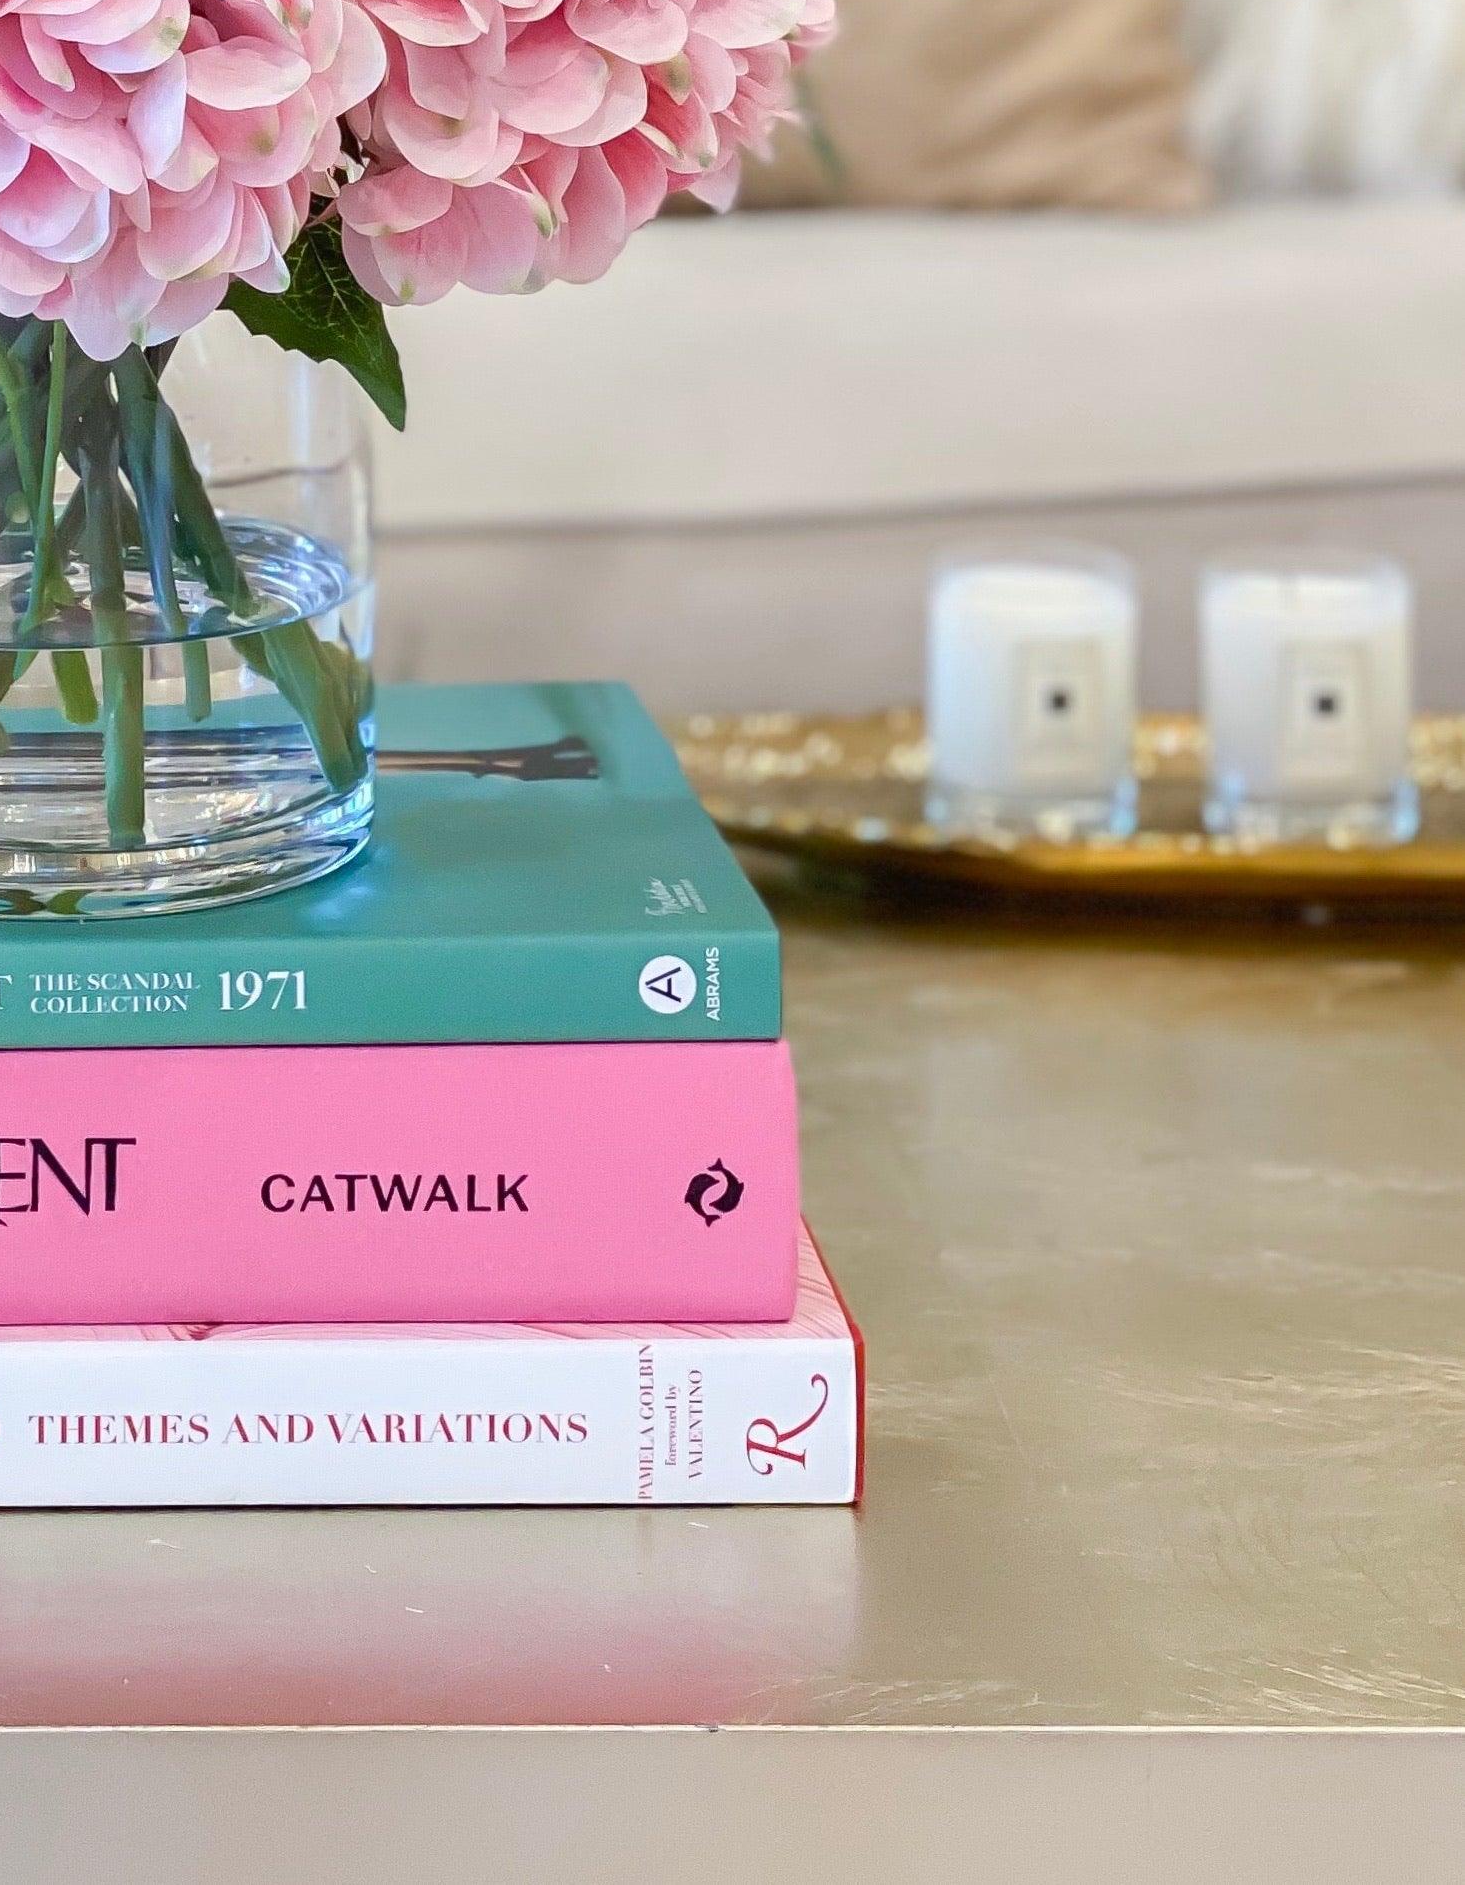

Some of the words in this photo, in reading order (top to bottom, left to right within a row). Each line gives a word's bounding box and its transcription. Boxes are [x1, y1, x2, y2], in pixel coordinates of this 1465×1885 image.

[29, 973, 82, 991] THE
[87, 971, 201, 991] SCANDAL
[218, 969, 307, 1011] 1971
[705, 946, 721, 1022] ABRAMS
[30, 994, 189, 1014] COLLECTION
[260, 1173, 530, 1212] CATWALK
[639, 1344, 655, 1420] GOLBIN
[665, 1384, 681, 1400] by
[28, 1413, 210, 1444] THEMES
[222, 1413, 315, 1444] AND
[324, 1412, 589, 1444] VARIATIONS
[665, 1405, 678, 1466] foreword
[688, 1369, 703, 1479] VALENTINO
[638, 1426, 655, 1499] PAMELA
